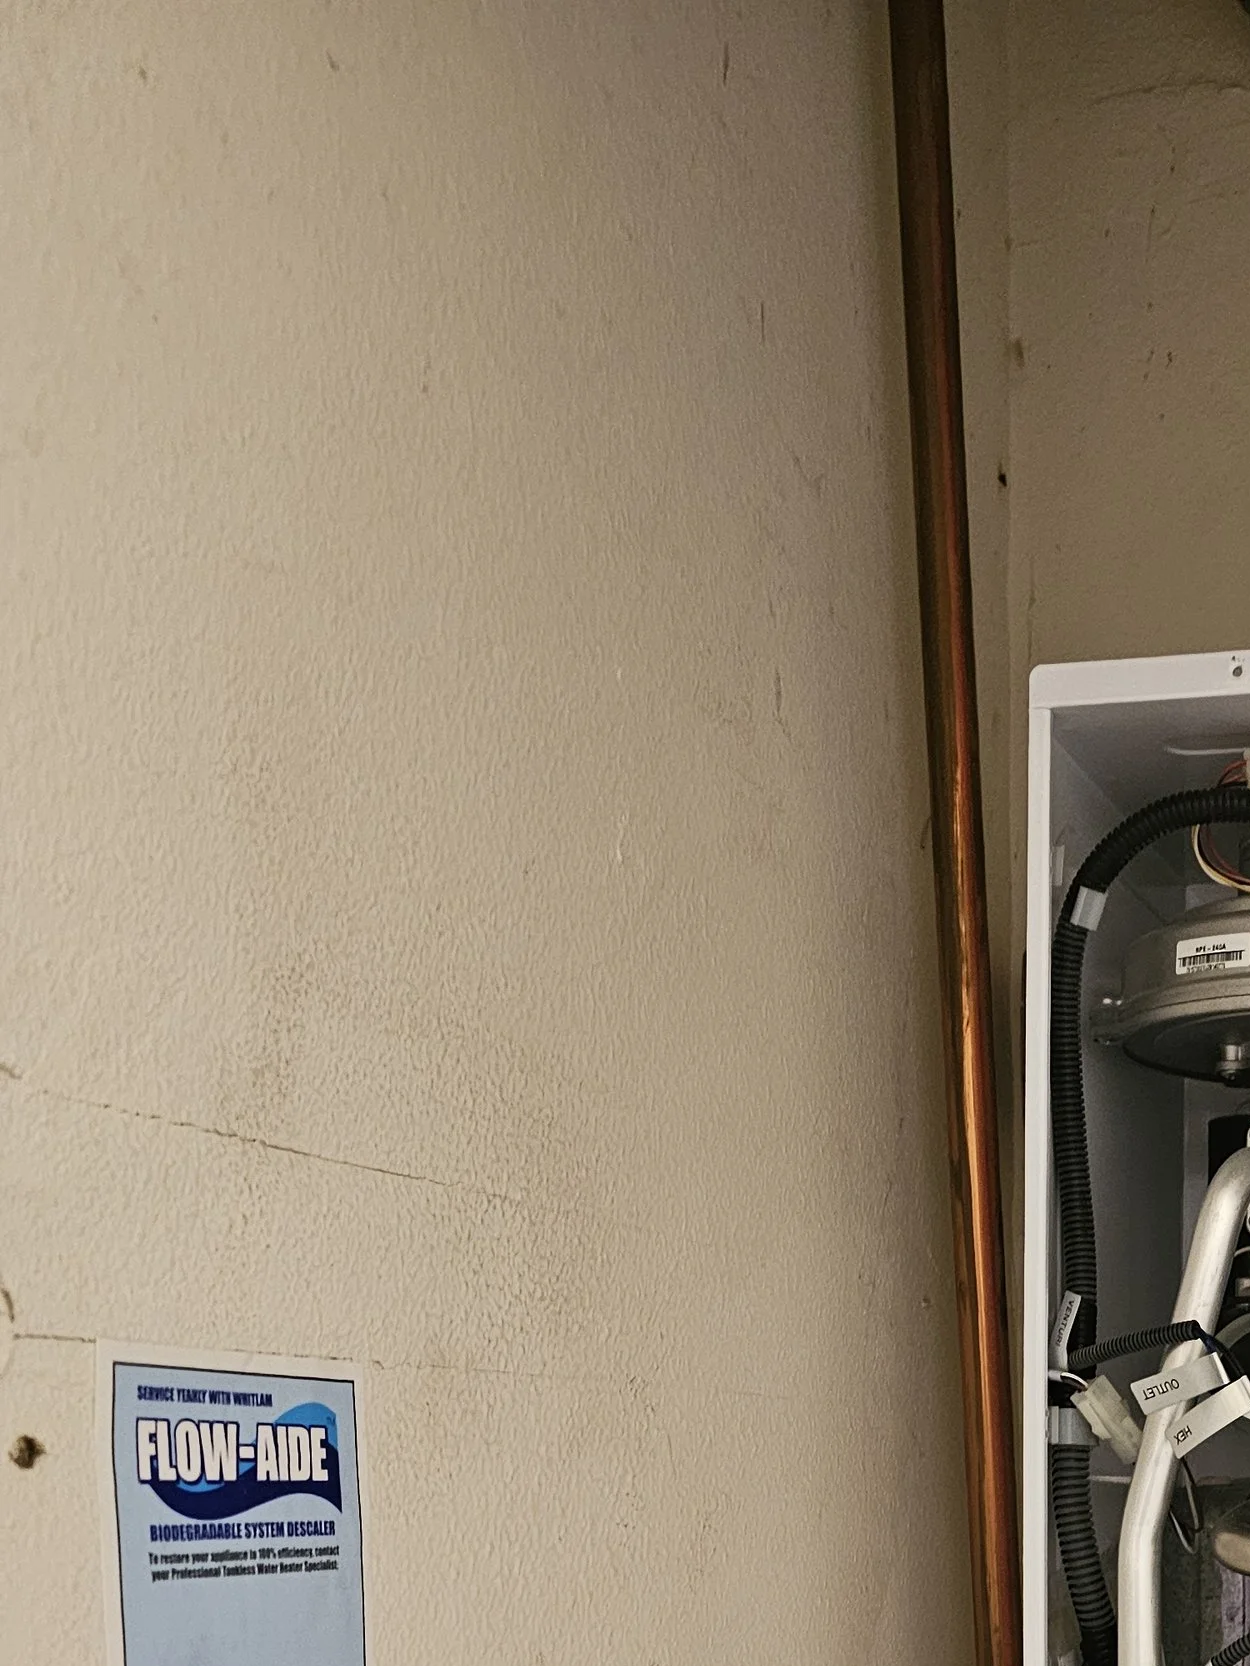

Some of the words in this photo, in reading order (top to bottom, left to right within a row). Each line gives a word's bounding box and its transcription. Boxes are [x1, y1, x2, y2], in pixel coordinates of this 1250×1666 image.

[1056, 1300, 1075, 1348] VENTURI
[137, 1385, 175, 1402] SERVICE
[177, 1388, 208, 1404] YEARLY
[208, 1390, 231, 1406] WITH
[1142, 1378, 1180, 1401] OUTLET
[1173, 1425, 1193, 1446] HEX
[136, 1417, 329, 1484] FLOW-AIDE
[150, 1523, 243, 1543] BIODEGRADABLE
[244, 1521, 285, 1539] SYSTEM
[286, 1520, 336, 1538] DESCALER
[160, 1552, 190, 1565] restore
[192, 1552, 209, 1568] your
[210, 1549, 248, 1563] appliance
[314, 1545, 340, 1557] contact
[152, 1569, 170, 1584] your
[171, 1565, 221, 1580] Professional
[222, 1563, 256, 1578] Tankless
[256, 1562, 279, 1575] Water
[279, 1560, 303, 1574] Heater
